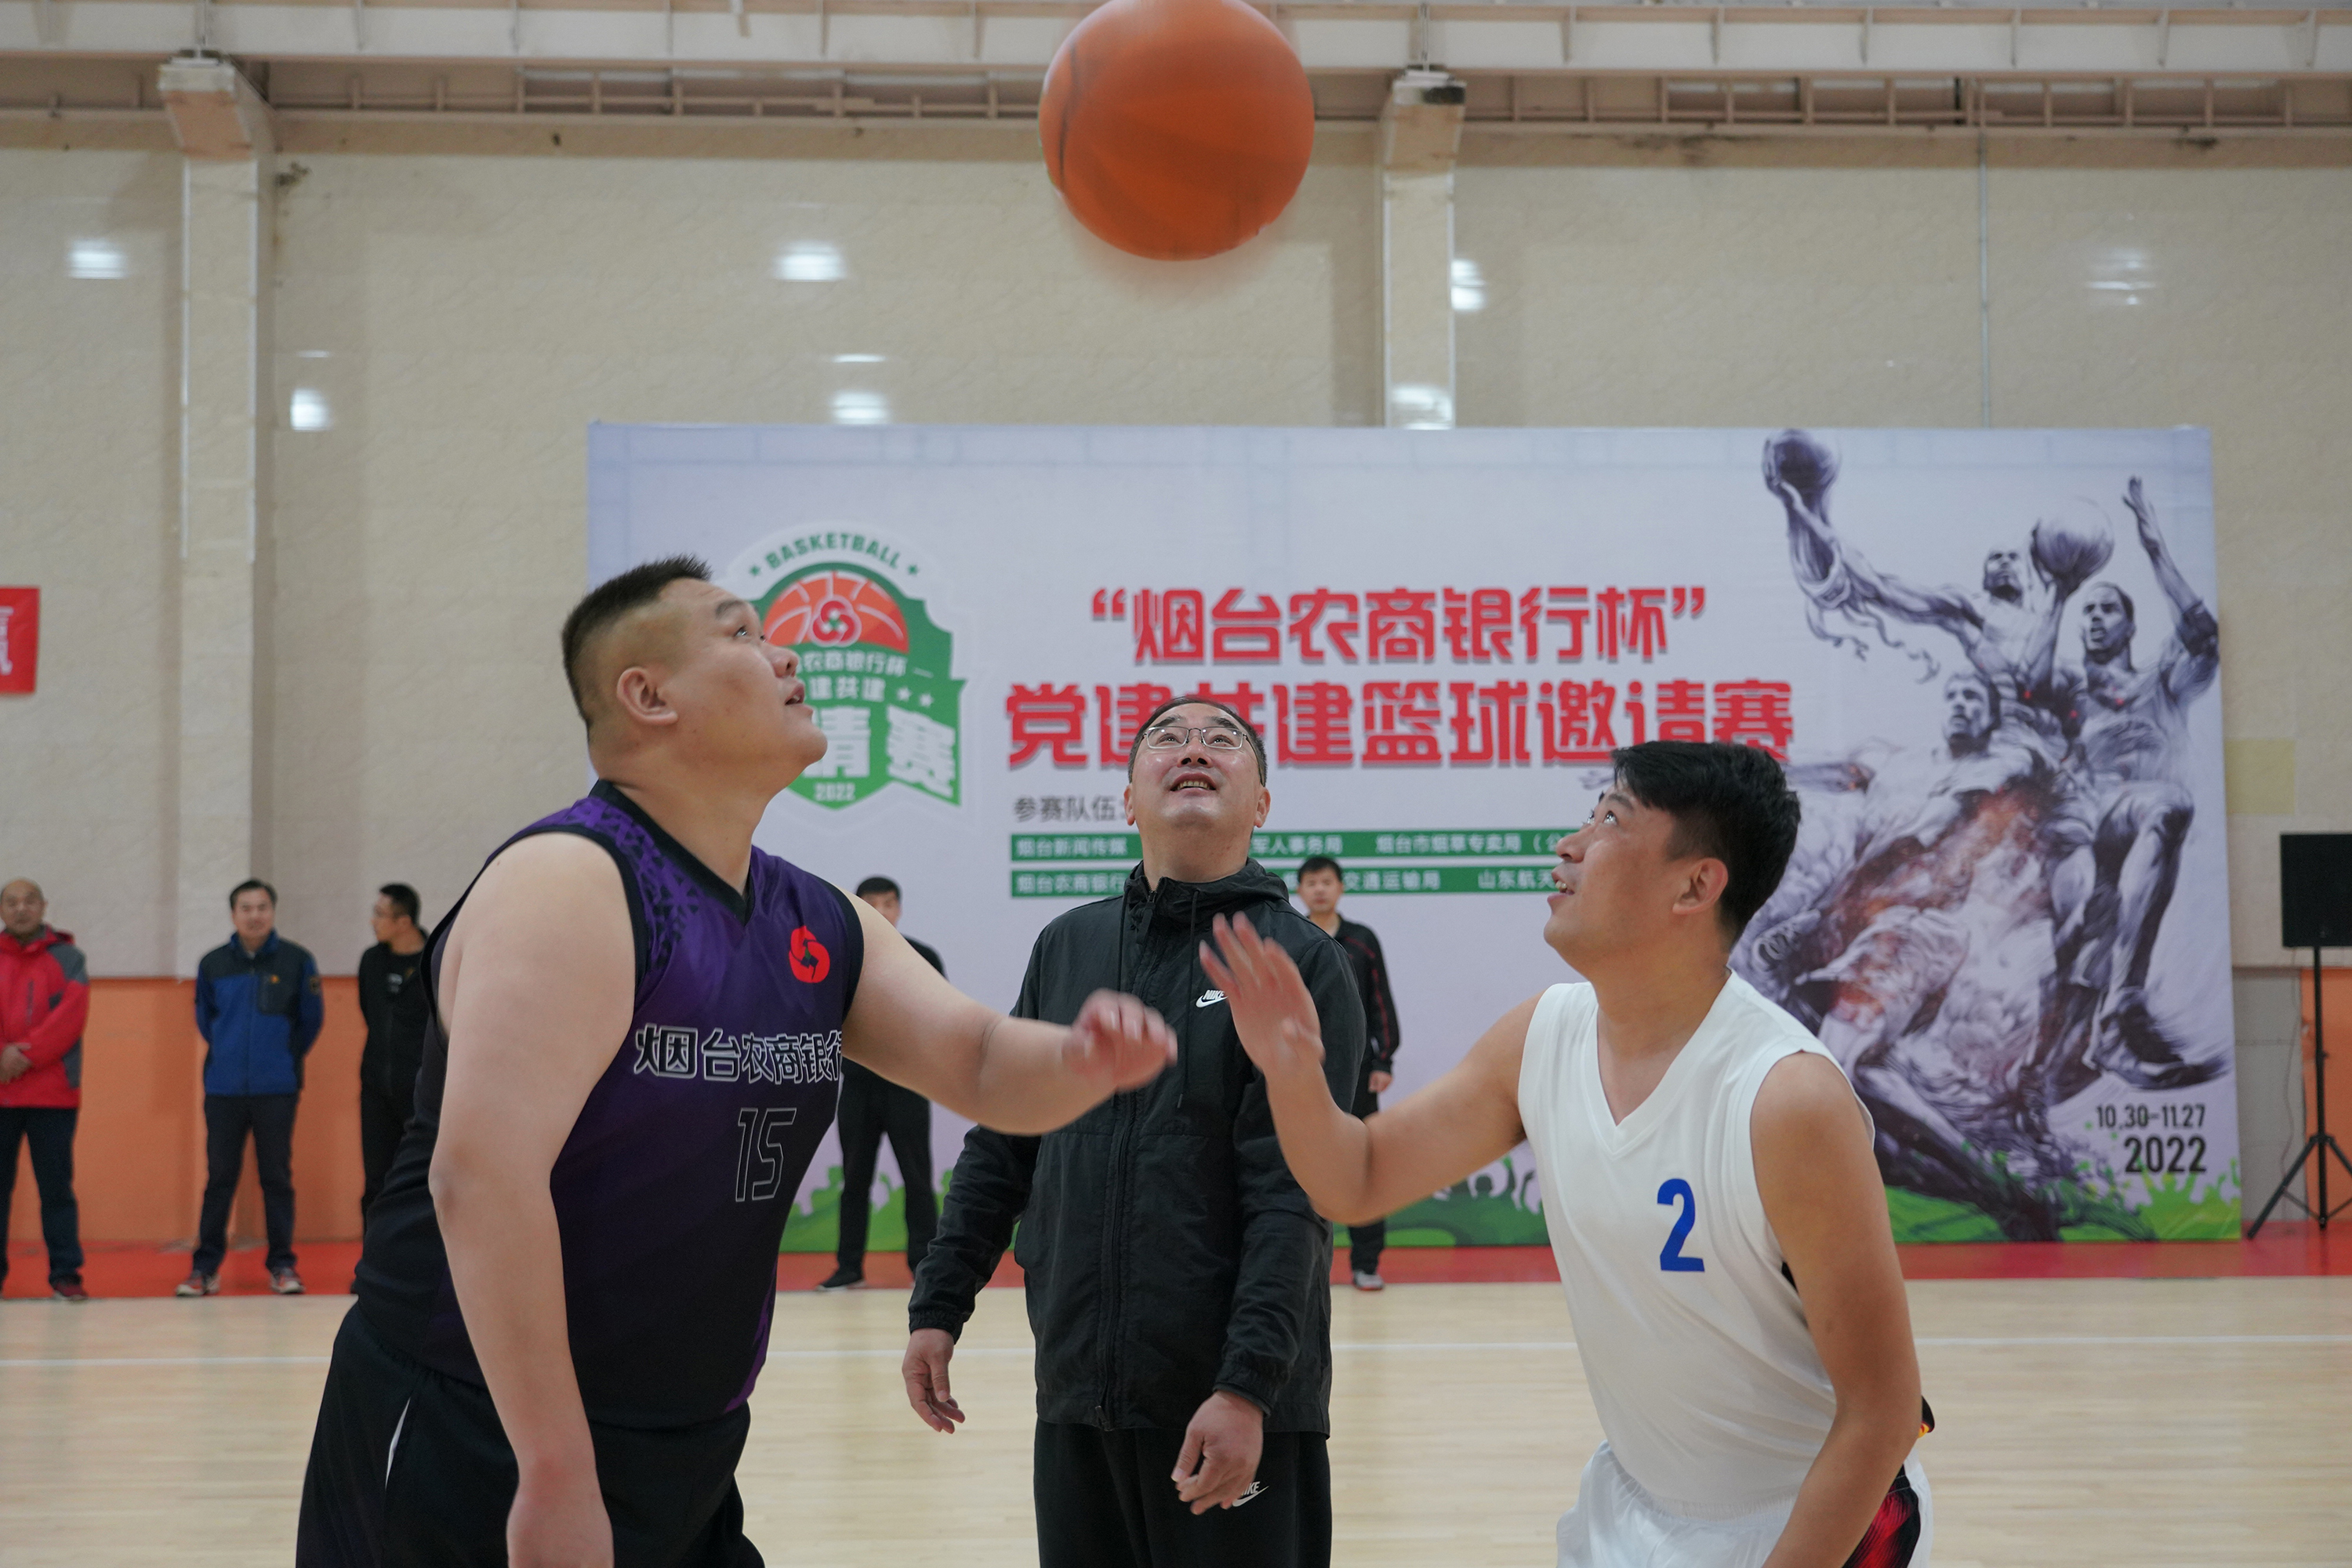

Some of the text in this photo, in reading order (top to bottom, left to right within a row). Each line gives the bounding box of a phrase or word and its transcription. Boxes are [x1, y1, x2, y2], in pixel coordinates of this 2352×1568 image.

[765, 532, 900, 570] BASKETBALL
[1091, 586, 1705, 661] “烟台农商银行杯”
[797, 650, 908, 677] 农商银行杯
[815, 783, 855, 800] 2022
[735, 1107, 797, 1203] 15
[2123, 1135, 2207, 1173] 2022
[1657, 1178, 1705, 1272] 2
[1241, 1481, 1261, 1496] IKE
